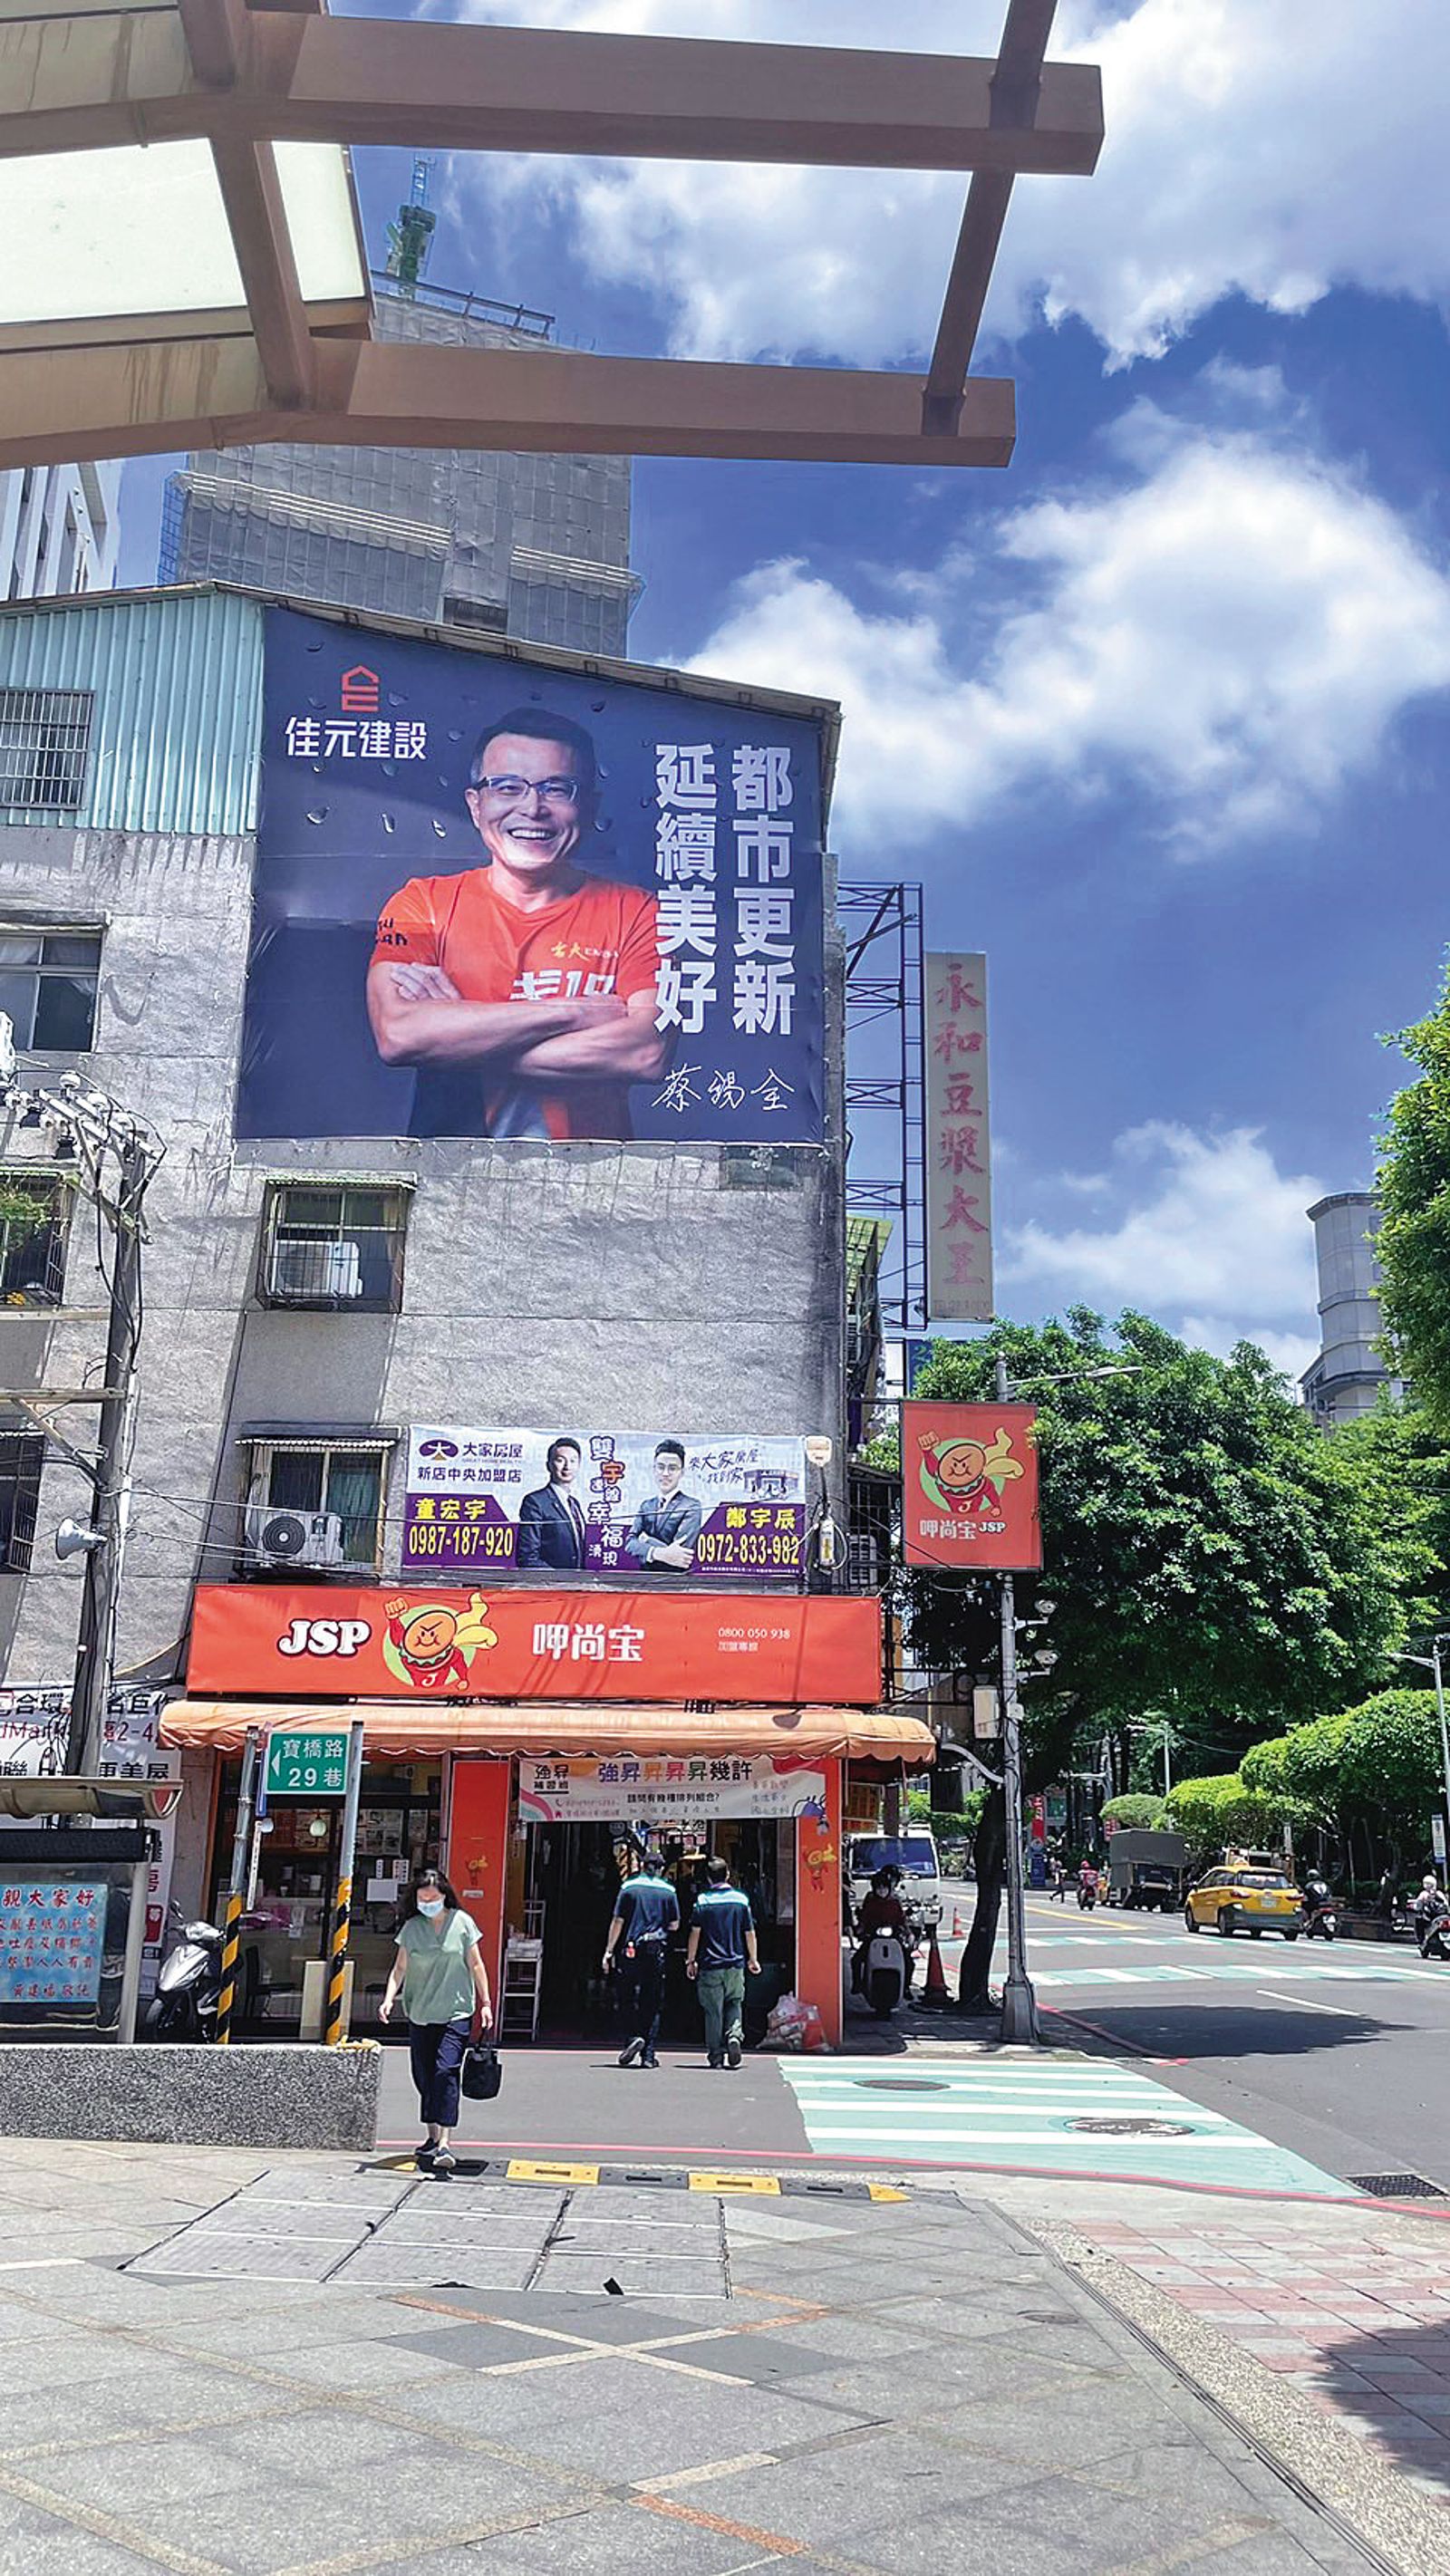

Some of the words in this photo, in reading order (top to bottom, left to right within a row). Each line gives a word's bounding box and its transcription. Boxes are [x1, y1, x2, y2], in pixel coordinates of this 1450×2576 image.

[285, 716, 427, 760] 佳元建設
[653, 743, 717, 1034] 延續美好
[732, 745, 796, 1035] 都市更新
[933, 962, 989, 1285] 永和豆漿大王
[463, 1442, 523, 1459] 大家房屋
[418, 1466, 522, 1483] 新店中央加盟店
[415, 1498, 487, 1521] 童宏宇
[726, 1506, 796, 1529] 鄭宇辰
[409, 1526, 514, 1557] 0987-187-920
[919, 1520, 977, 1540] 呷尚宝
[979, 1521, 1006, 1534] JSP
[697, 1533, 799, 1566] 0972-833-982
[279, 1619, 369, 1656] JSP
[531, 1624, 644, 1663] 呷尚宝
[718, 1627, 744, 1638] 0800
[747, 1628, 768, 1639] 050
[770, 1628, 791, 1639] 938
[283, 1739, 344, 1760] 寶橋路
[598, 1761, 753, 1783] 強昇昇昇昇幾許
